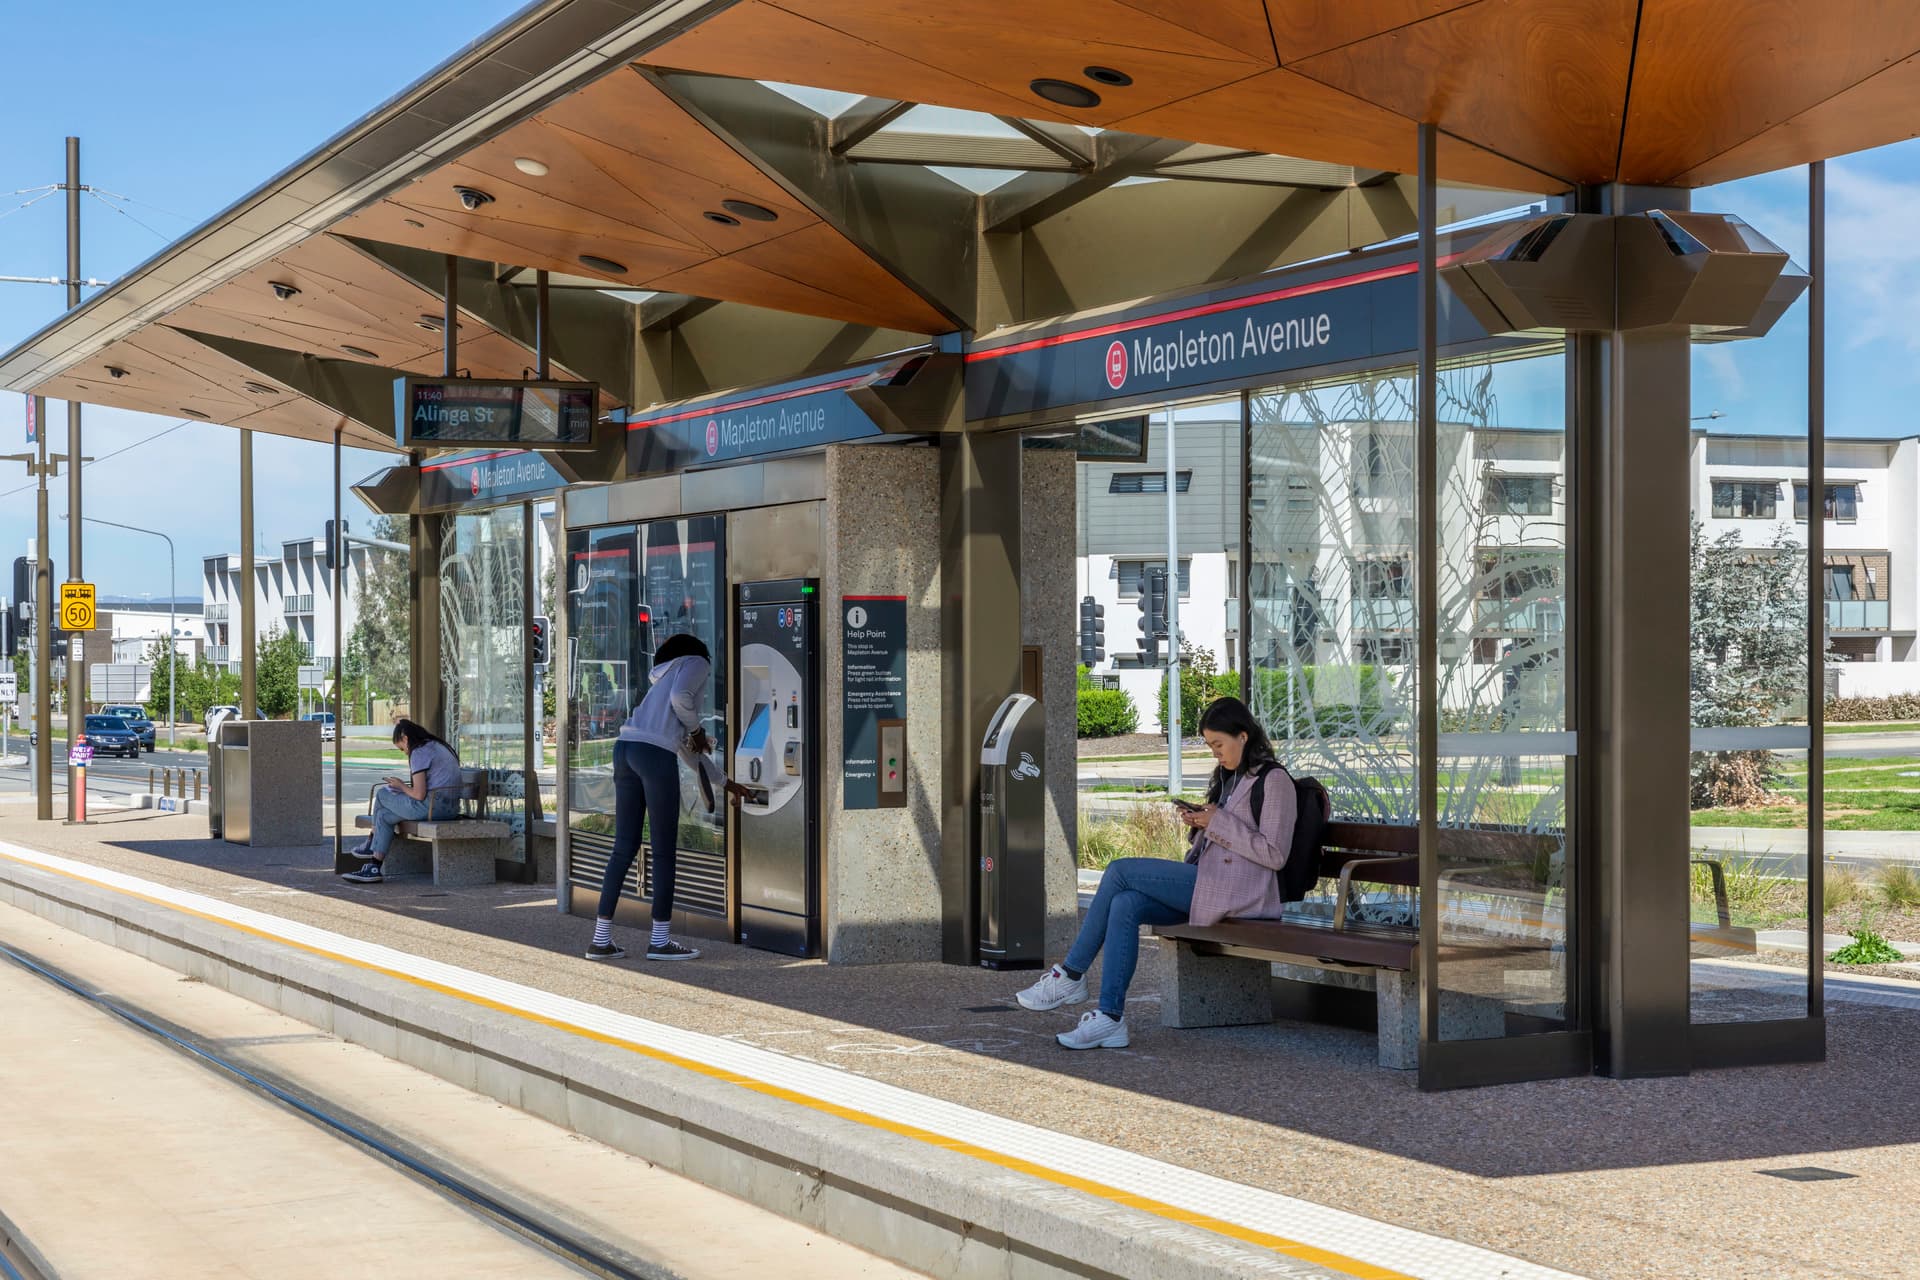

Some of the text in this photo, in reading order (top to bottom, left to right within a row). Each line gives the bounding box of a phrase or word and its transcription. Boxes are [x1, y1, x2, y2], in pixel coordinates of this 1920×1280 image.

[1133, 313, 1331, 382] Mapleton Avenue
[414, 404, 495, 426] Alinga St
[570, 418, 589, 429] min
[721, 407, 825, 452] Mapleton Avenue
[480, 461, 546, 490] Mapleton Avenue
[69, 607, 87, 622] 50
[847, 630, 887, 639] Help Point
[0, 689, 14, 697] NLY
